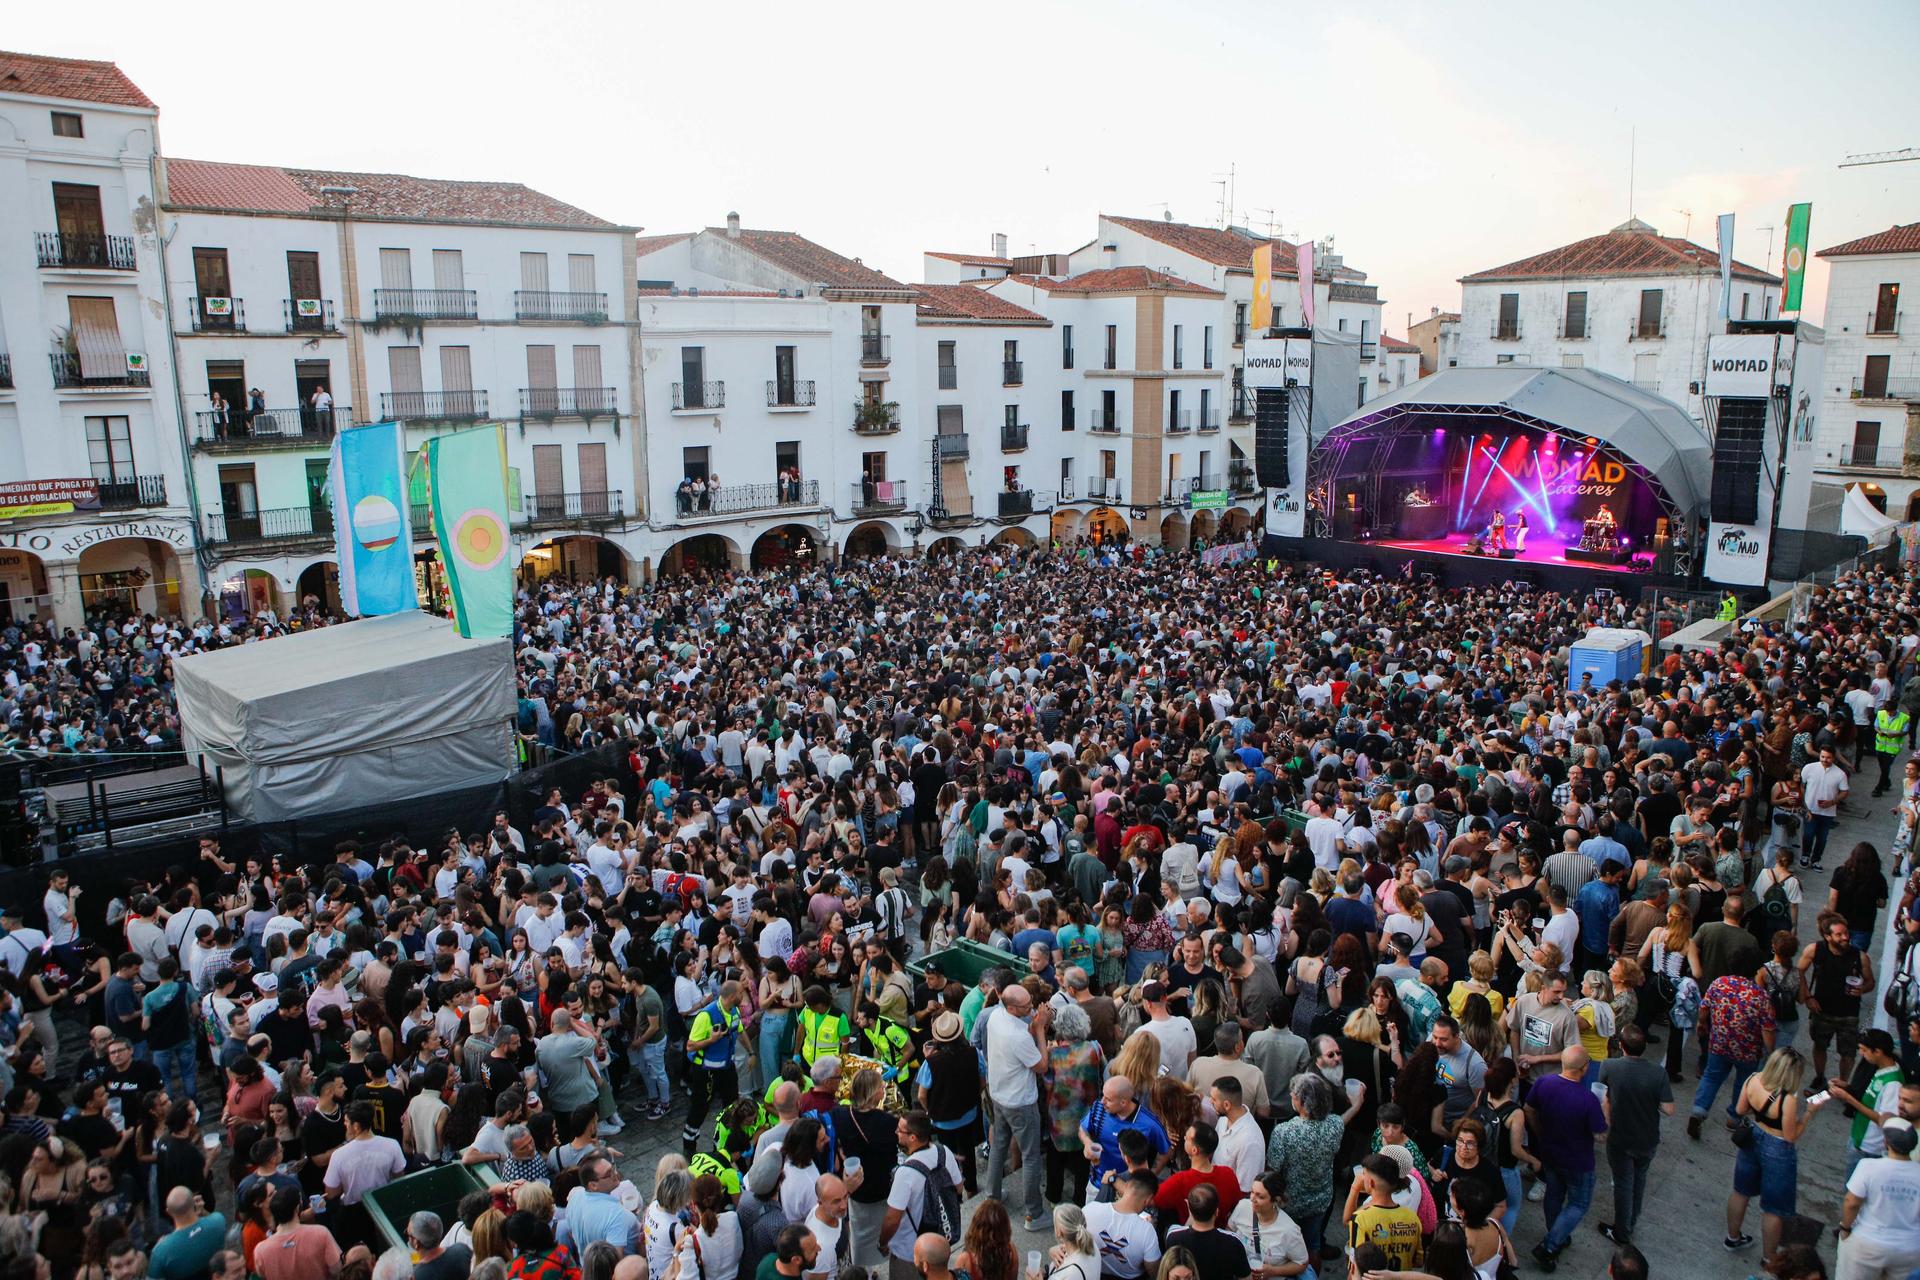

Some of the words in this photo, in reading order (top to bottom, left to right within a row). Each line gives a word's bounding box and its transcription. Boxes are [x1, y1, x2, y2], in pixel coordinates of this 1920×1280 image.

[1247, 357, 1282, 369] WOMAD
[1287, 356, 1310, 368] WOMAD
[1712, 359, 1768, 372] WOMAD
[1511, 457, 1626, 484] WOMAD
[38, 481, 53, 491] QUE
[55, 480, 80, 490] PONGA
[82, 479, 95, 488] FIN
[8, 495, 18, 504] DE
[20, 494, 29, 503] LA
[30, 491, 72, 502] POBLACIÓN
[73, 490, 94, 499] CIVIL
[62, 523, 188, 555] RESTAURANTE
[845, 920, 874, 935] RAIDERS
